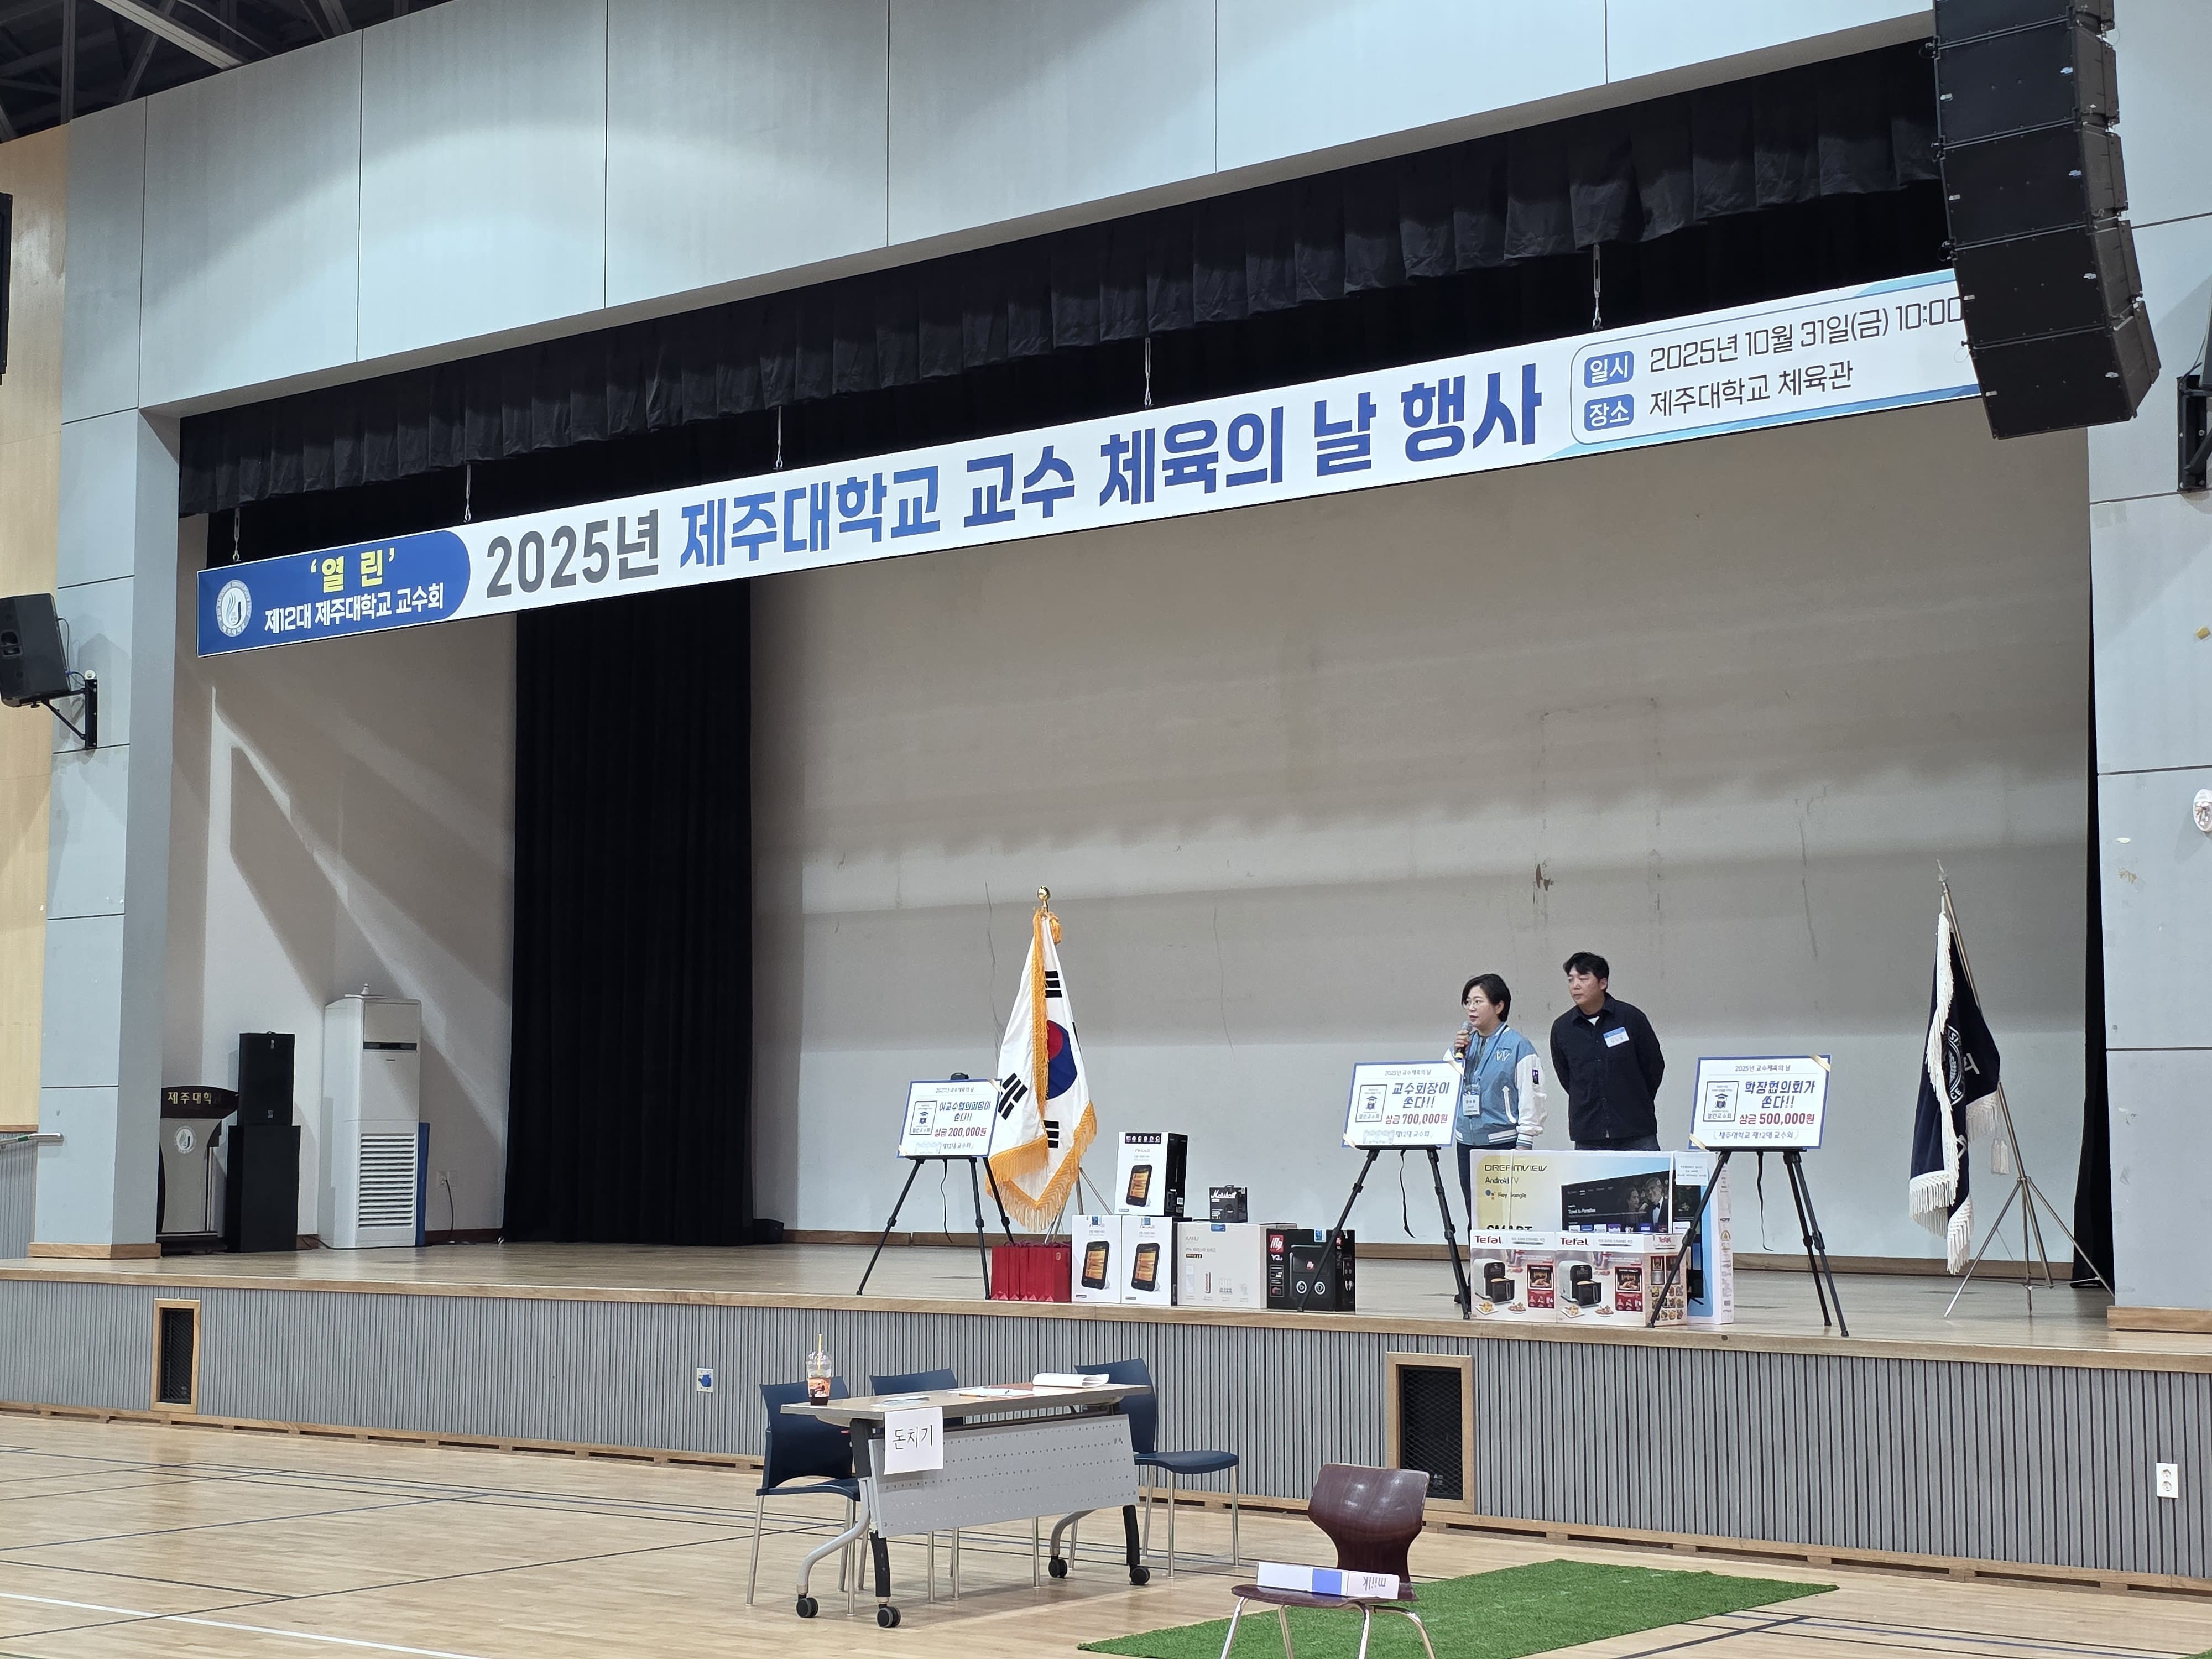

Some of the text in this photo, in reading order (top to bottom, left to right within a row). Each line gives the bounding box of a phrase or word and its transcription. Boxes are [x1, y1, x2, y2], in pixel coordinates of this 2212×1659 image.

[1650, 297, 1963, 372] 2025년 10월 31일(금) 10:00
[1589, 355, 1629, 384] 일시
[1650, 360, 1853, 416] 제주대학교 체육관
[1589, 400, 1630, 427] 장소
[487, 363, 1542, 598] 2025년 제주대학교 교수 체육의 날 행사
[265, 603, 311, 633] 제12대
[315, 591, 392, 626] 제주대학교
[395, 582, 444, 614] 교수회
[1392, 1082, 1450, 1094] 교수회장이
[1745, 1081, 1815, 1094] 학장협의회가
[168, 1092, 221, 1104] 제주대학
[1403, 1096, 1436, 1108] 쏜다!!
[1761, 1095, 1794, 1108] 쏜다!!
[1385, 1113, 1448, 1125] 상금 700,000원
[1739, 1113, 1814, 1125] 상금 500,000원
[948, 1127, 987, 1138] 200,000원
[1474, 1235, 1501, 1244] Tefal
[1559, 1237, 1589, 1245] Tefal
[892, 1424, 933, 1450] 돈치기
